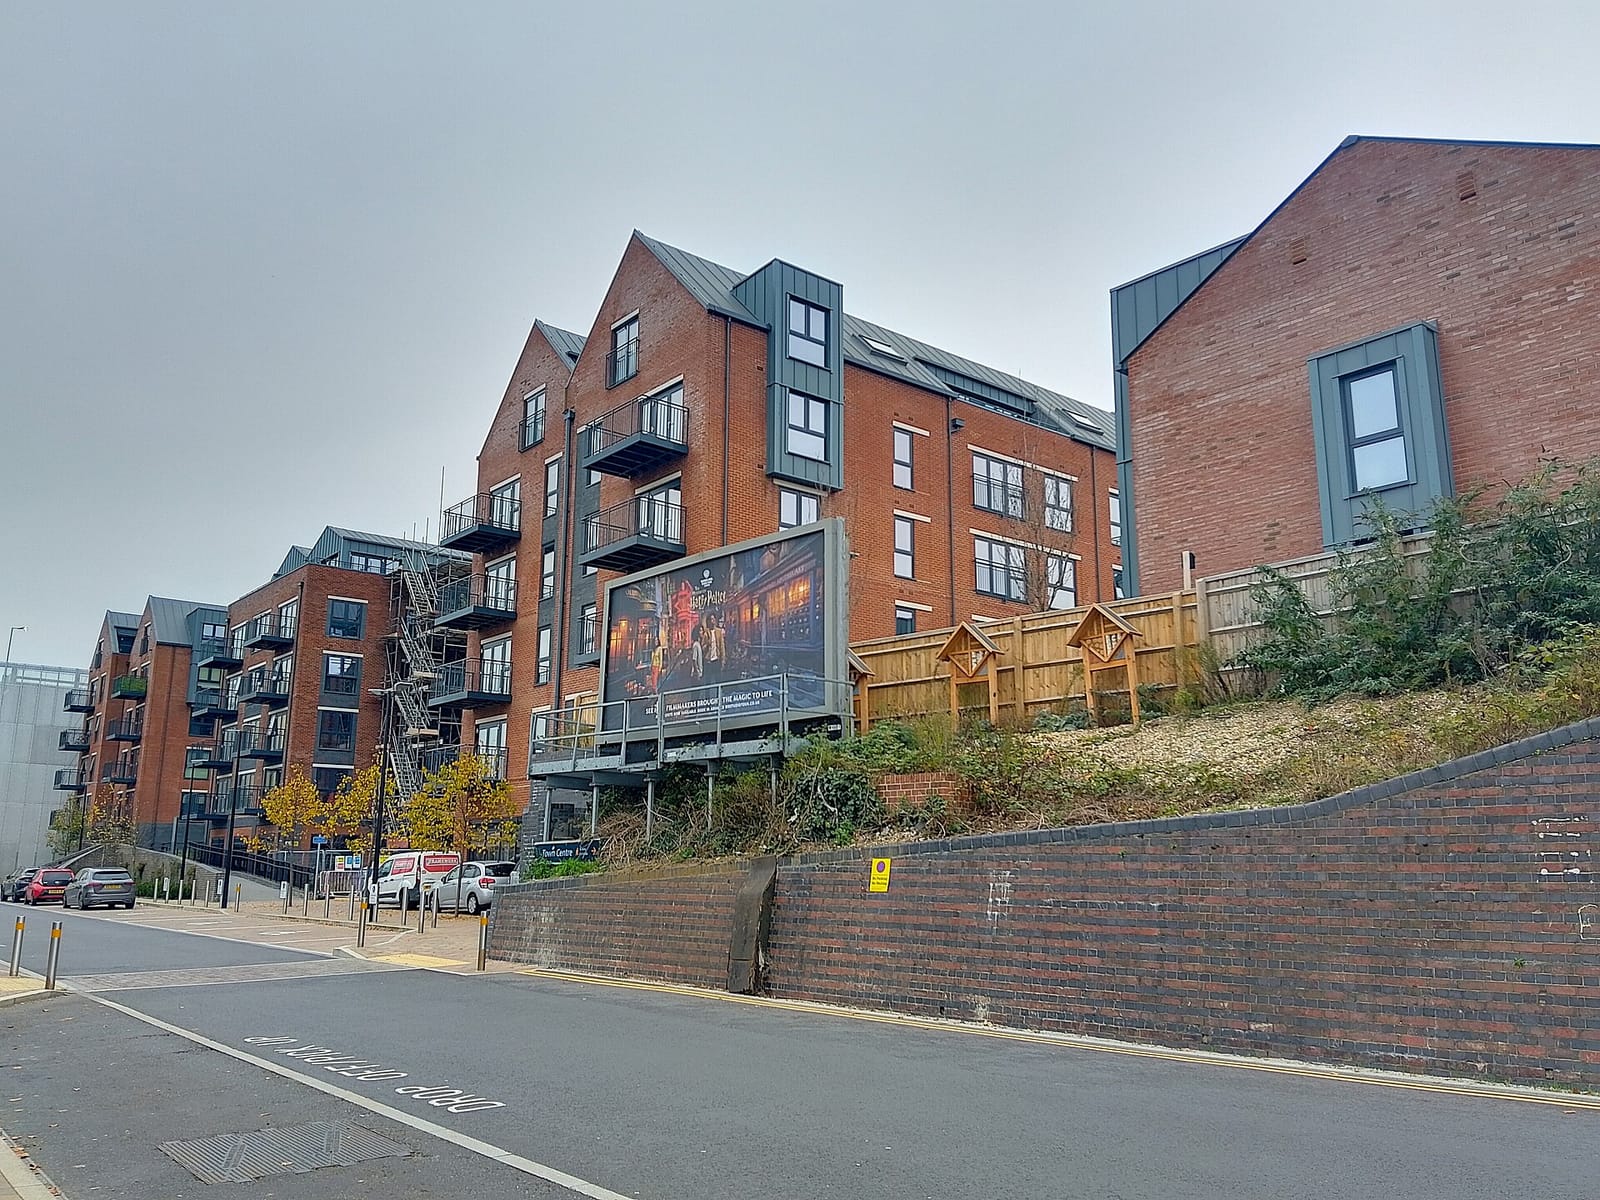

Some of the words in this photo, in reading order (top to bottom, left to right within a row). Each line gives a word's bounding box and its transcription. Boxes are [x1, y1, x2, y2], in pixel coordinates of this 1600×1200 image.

[665, 701, 697, 712] FILMMAKERS
[697, 698, 720, 708] BROUGH
[722, 696, 732, 704] THE
[733, 693, 752, 702] MAGIC
[752, 691, 760, 699] TO
[761, 690, 773, 698] LIFE
[542, 848, 555, 858] Town
[556, 848, 573, 857] Centre
[243, 1035, 299, 1047] UP
[394, 1085, 507, 1114] DROP
